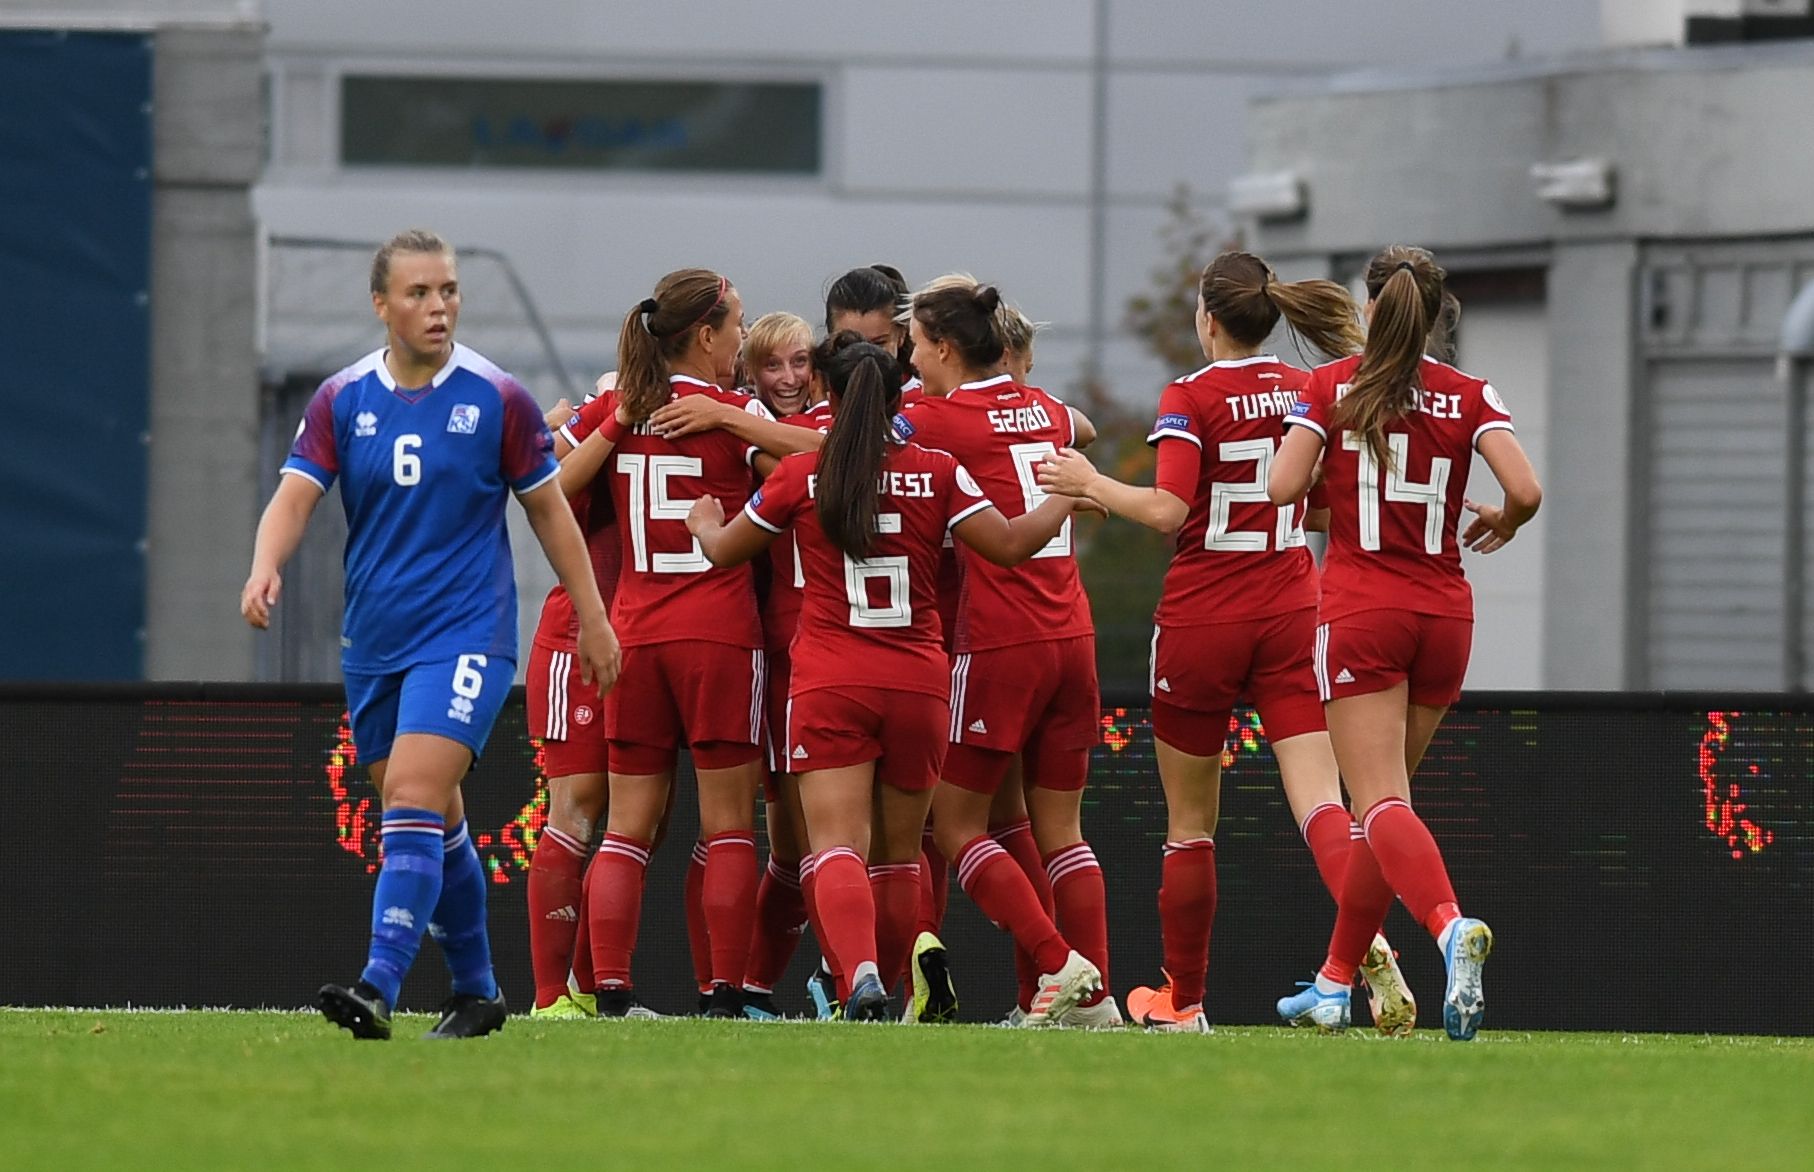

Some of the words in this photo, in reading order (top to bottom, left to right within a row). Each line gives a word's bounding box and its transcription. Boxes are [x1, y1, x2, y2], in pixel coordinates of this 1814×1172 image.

[987, 400, 1051, 432] SZABÓ
[393, 434, 423, 487] 6
[1342, 430, 1452, 555] 14
[617, 453, 713, 573] 15
[843, 512, 912, 627] 6
[452, 654, 488, 701] 6
